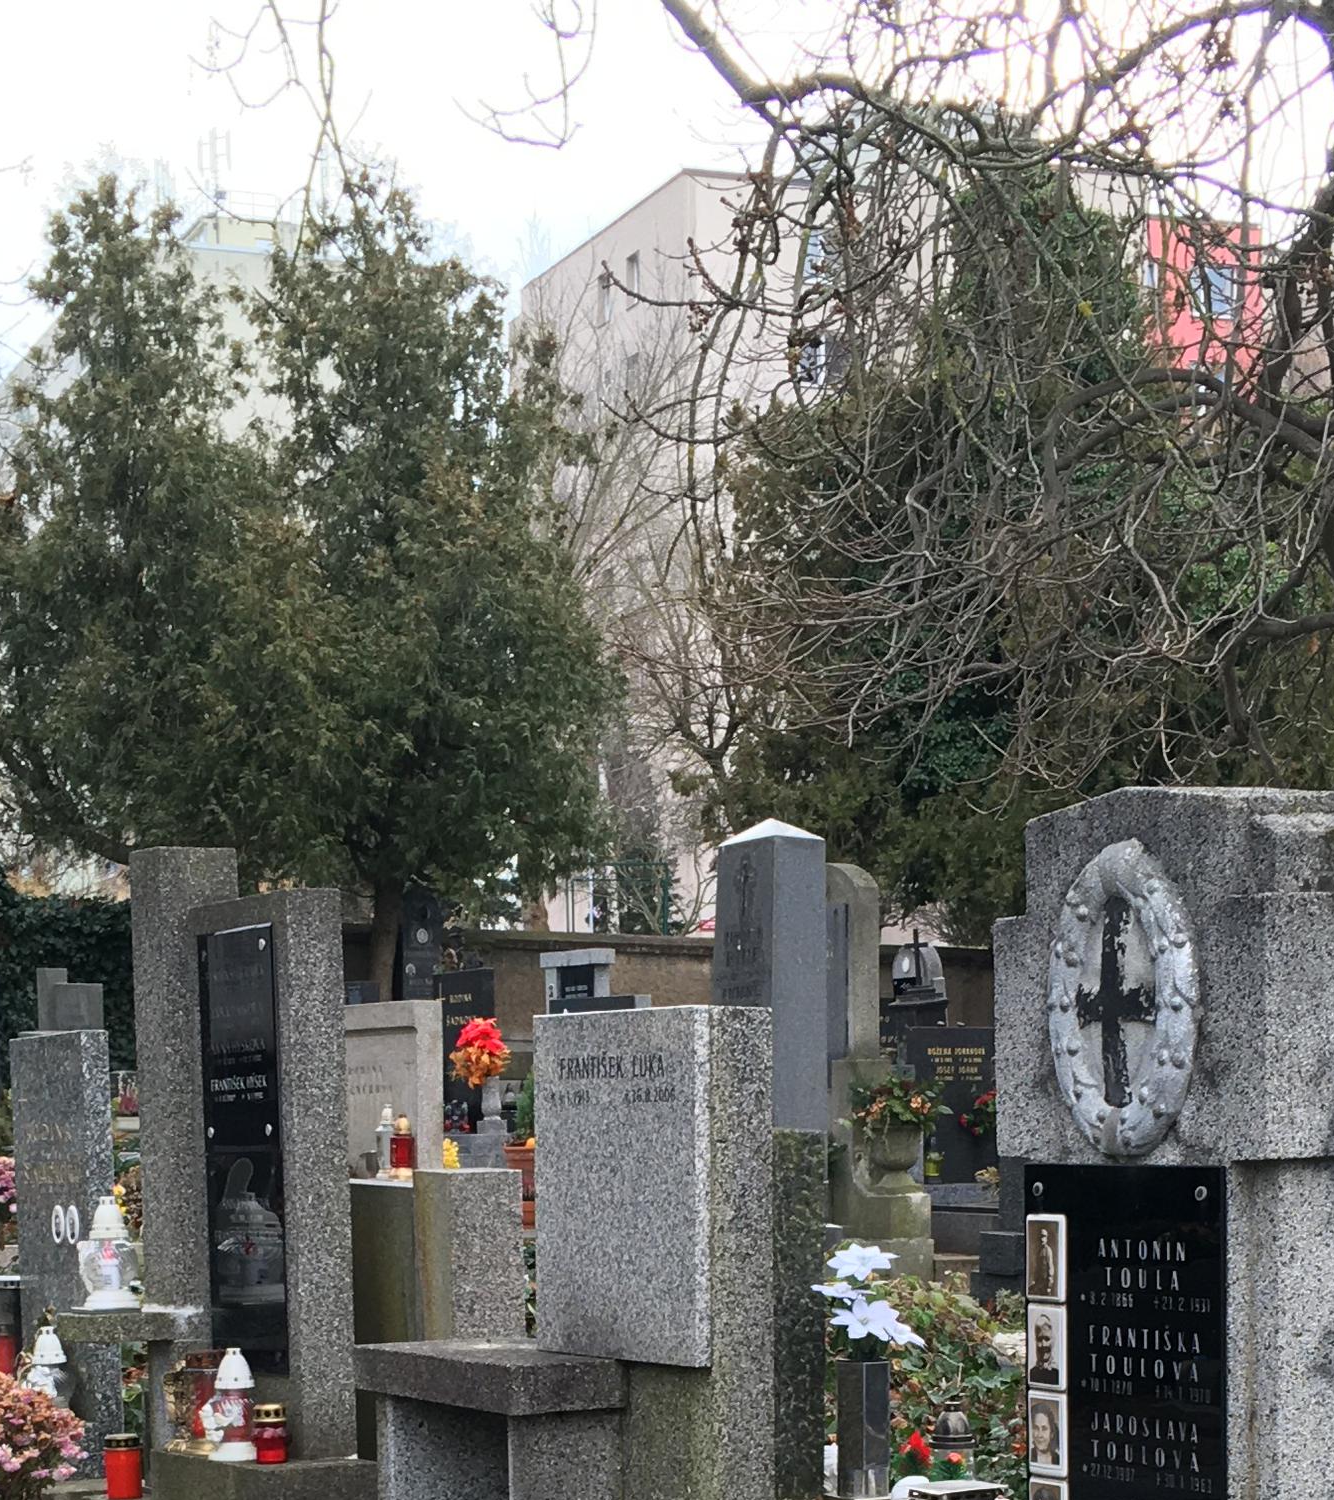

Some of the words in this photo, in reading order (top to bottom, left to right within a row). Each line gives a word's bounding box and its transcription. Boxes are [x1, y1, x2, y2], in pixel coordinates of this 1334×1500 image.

[559, 1052, 625, 1080] FRANTIŠEK
[210, 1074, 246, 1092] FRANTIŠEK
[1105, 1266, 1179, 1291] TOULA
[1088, 1324, 1201, 1354] FRANTIŠKA
[1090, 1411, 1199, 1444] JAROSLAVA
